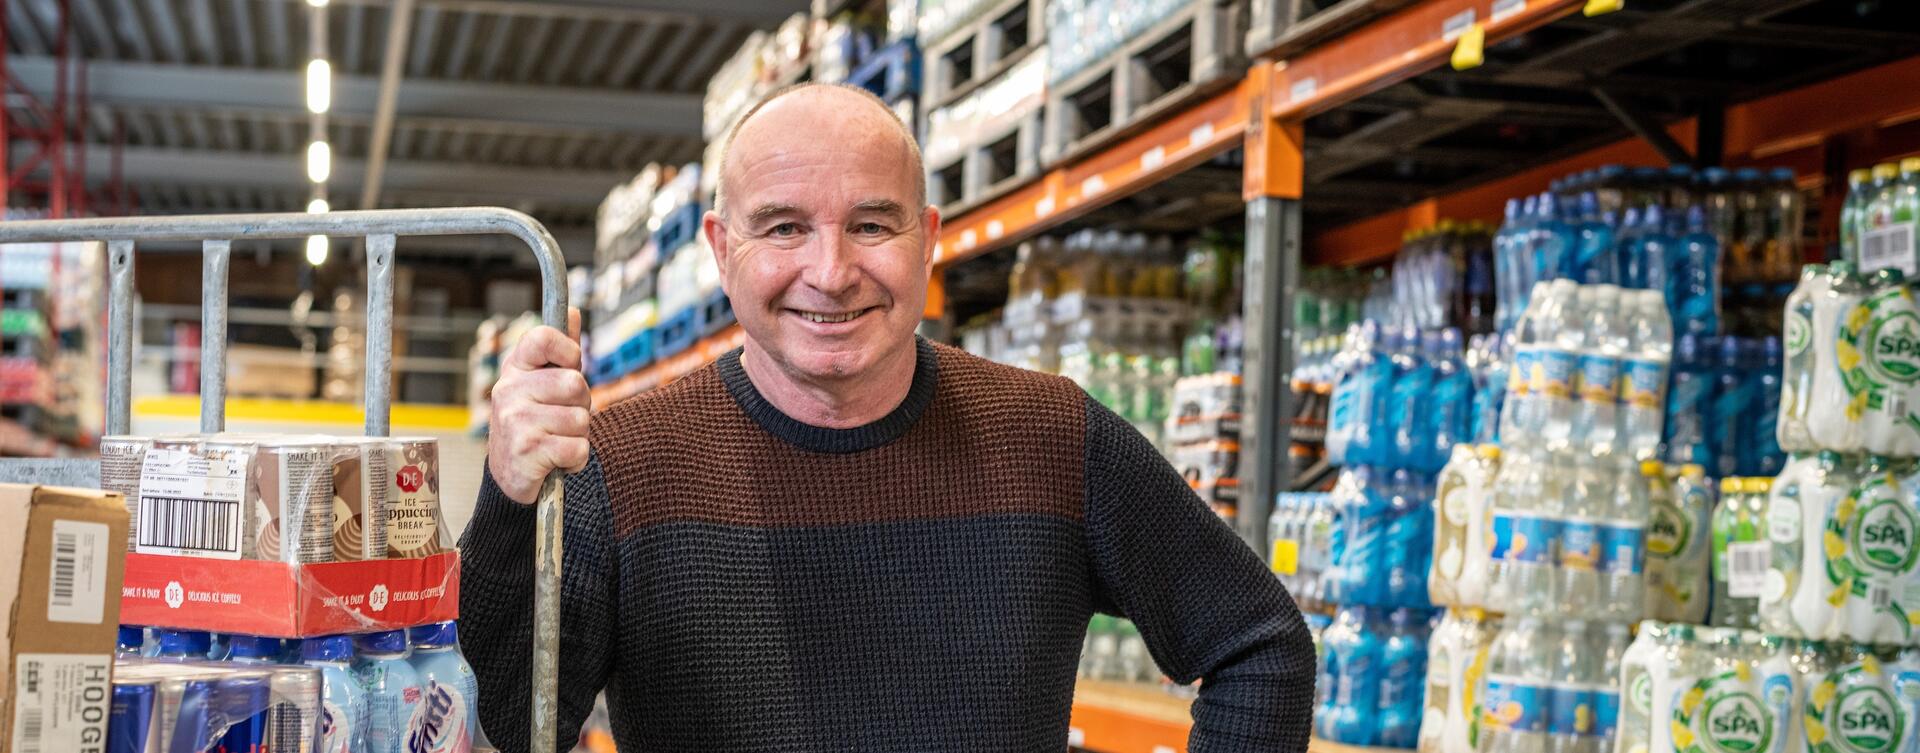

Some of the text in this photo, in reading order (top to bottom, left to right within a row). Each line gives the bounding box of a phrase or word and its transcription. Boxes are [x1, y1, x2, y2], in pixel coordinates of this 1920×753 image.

[287, 452, 309, 462] SHAKE
[310, 452, 317, 461] IT
[404, 498, 417, 507] ICE
[397, 520, 424, 530] BREAK
[1864, 523, 1908, 548] SPA
[187, 590, 211, 603] DELICIOUS
[211, 591, 220, 604] ICE
[392, 590, 420, 603] DELICIOUS
[1713, 714, 1761, 735] SPA
[1842, 710, 1891, 732] SPA
